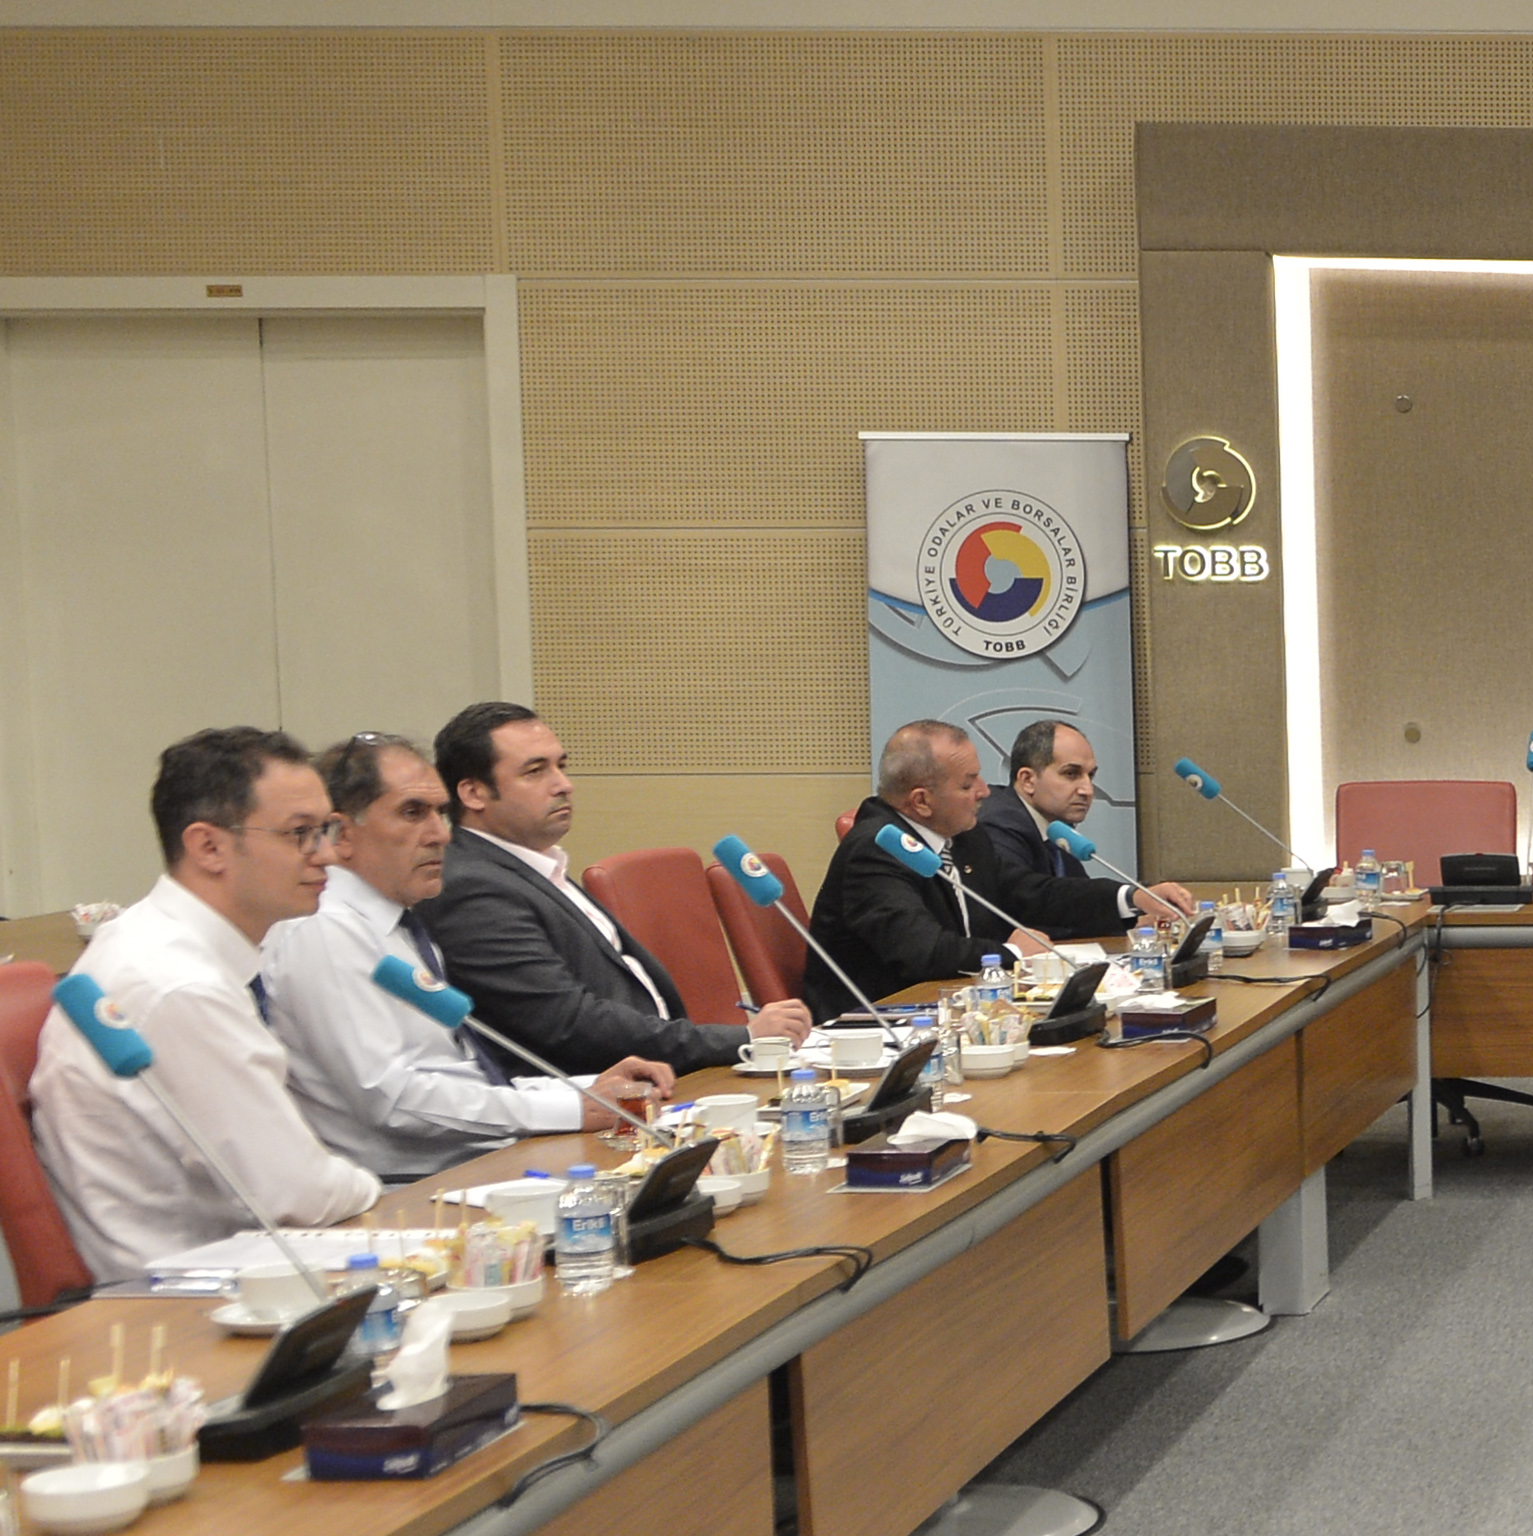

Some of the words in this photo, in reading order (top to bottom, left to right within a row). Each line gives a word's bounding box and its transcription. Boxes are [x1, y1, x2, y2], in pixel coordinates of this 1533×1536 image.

[927, 503, 976, 557] ODALAR
[982, 497, 1003, 509] VE
[1011, 499, 1076, 568] BORSALAR
[1153, 545, 1269, 581] TOBB
[983, 639, 1026, 653] TOBB
